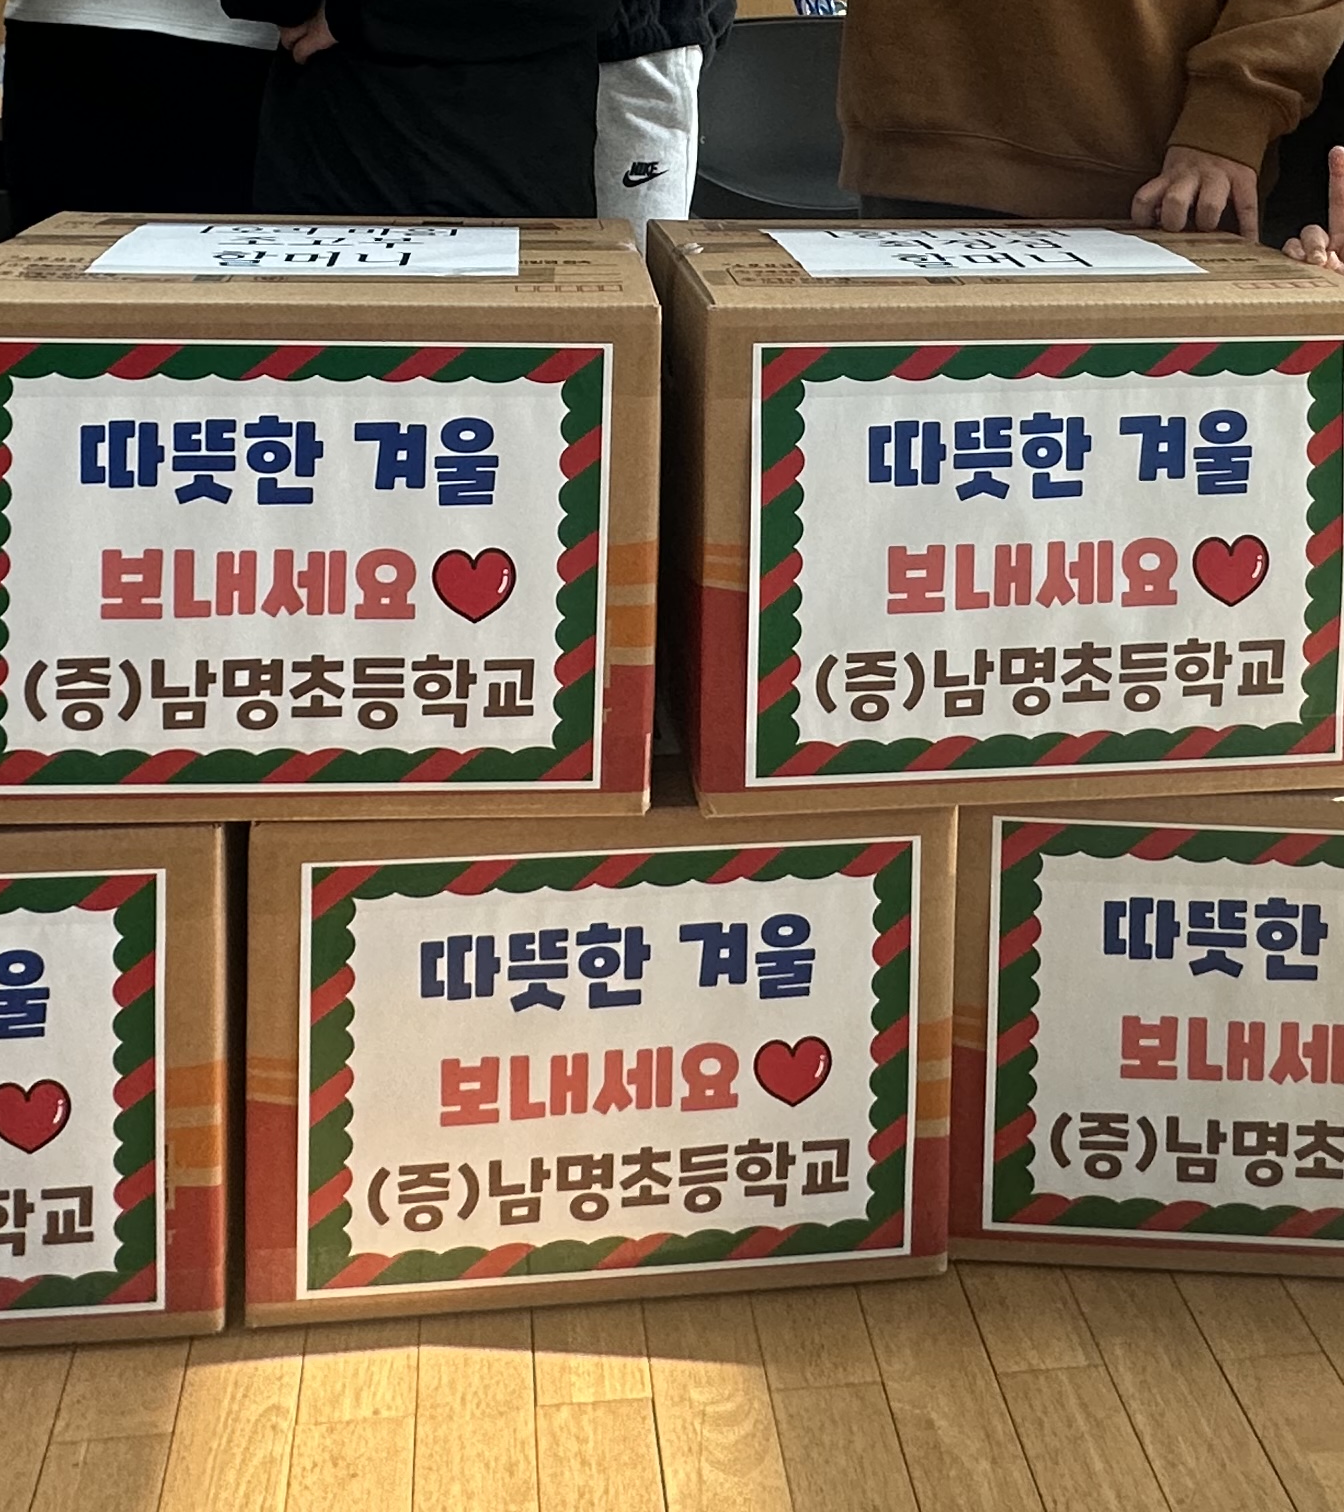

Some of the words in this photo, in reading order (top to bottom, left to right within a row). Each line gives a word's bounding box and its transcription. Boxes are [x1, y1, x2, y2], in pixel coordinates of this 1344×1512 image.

[628, 161, 660, 177] NIKE
[211, 250, 412, 268] 할머니
[891, 251, 1094, 268] 할머니
[81, 416, 323, 505] 따뜻한
[355, 418, 499, 506] 겨울
[869, 413, 1091, 501] 따뜻한
[1120, 410, 1252, 495] 겨울
[102, 549, 416, 619] 보내세요
[887, 539, 1178, 614] 보내세요
[25, 655, 534, 731] (증)남명초등학교
[816, 638, 1285, 723] (증)남명초등학교
[421, 923, 651, 1012] 따뜻한
[680, 914, 815, 999] 겨울
[1104, 897, 1328, 981] 따뜻한
[440, 1043, 740, 1128] 보내세요
[368, 1139, 850, 1233] (증)남명초등학교
